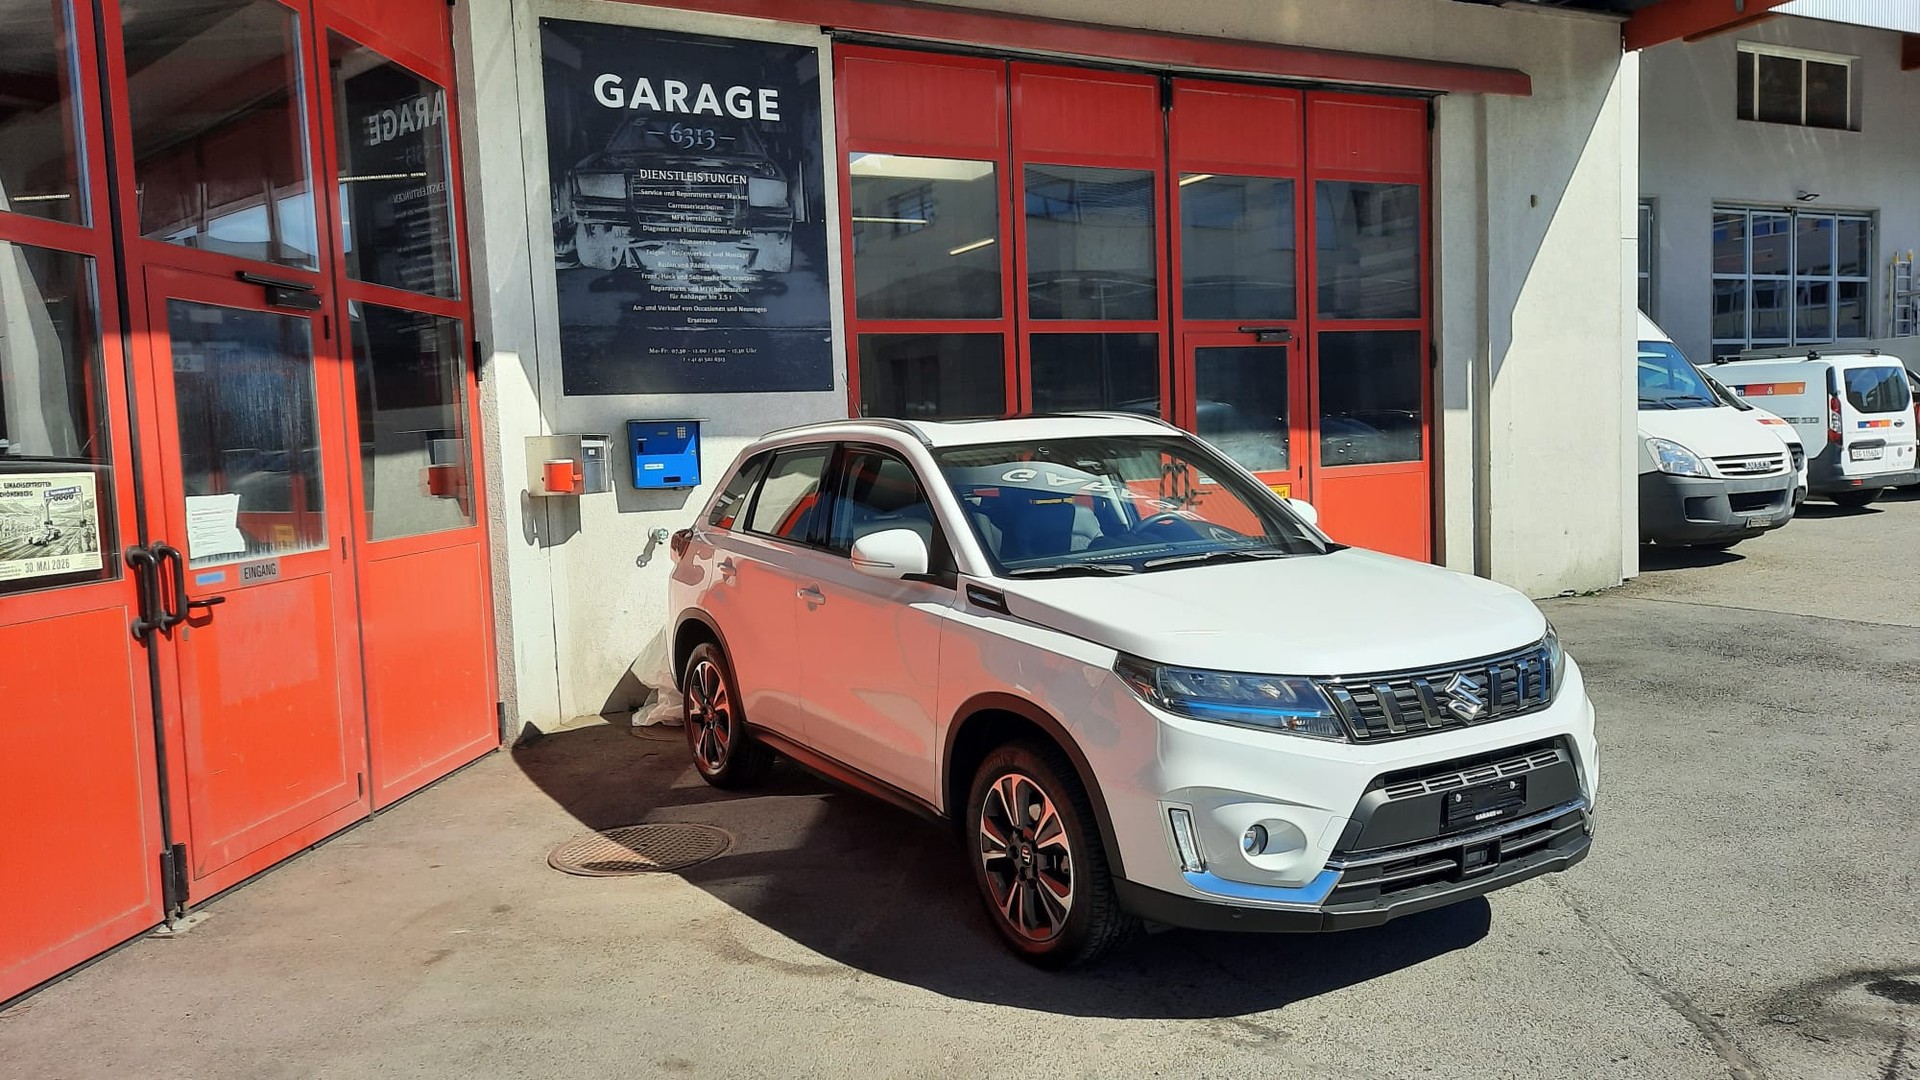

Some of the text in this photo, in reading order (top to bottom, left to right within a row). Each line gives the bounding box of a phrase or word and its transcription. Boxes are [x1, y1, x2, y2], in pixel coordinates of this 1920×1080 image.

[593, 73, 781, 122] GARAGE
[670, 122, 716, 150] 6313
[640, 168, 747, 185] DIENSTLEISTUNGEN
[640, 188, 662, 196] Service
[676, 190, 712, 199] Reparaturen
[713, 192, 726, 200] aller
[642, 225, 670, 233] Diagnose
[683, 226, 728, 234] Elektroarbeiten
[680, 238, 716, 246] Klimaservice
[680, 292, 708, 301] Anhänger
[738, 306, 768, 314] Neuwagen
[25, 562, 36, 574] 30.
[36, 560, 50, 572] MAI
[52, 558, 70, 570] 2026
[244, 563, 276, 579] EINGANG
